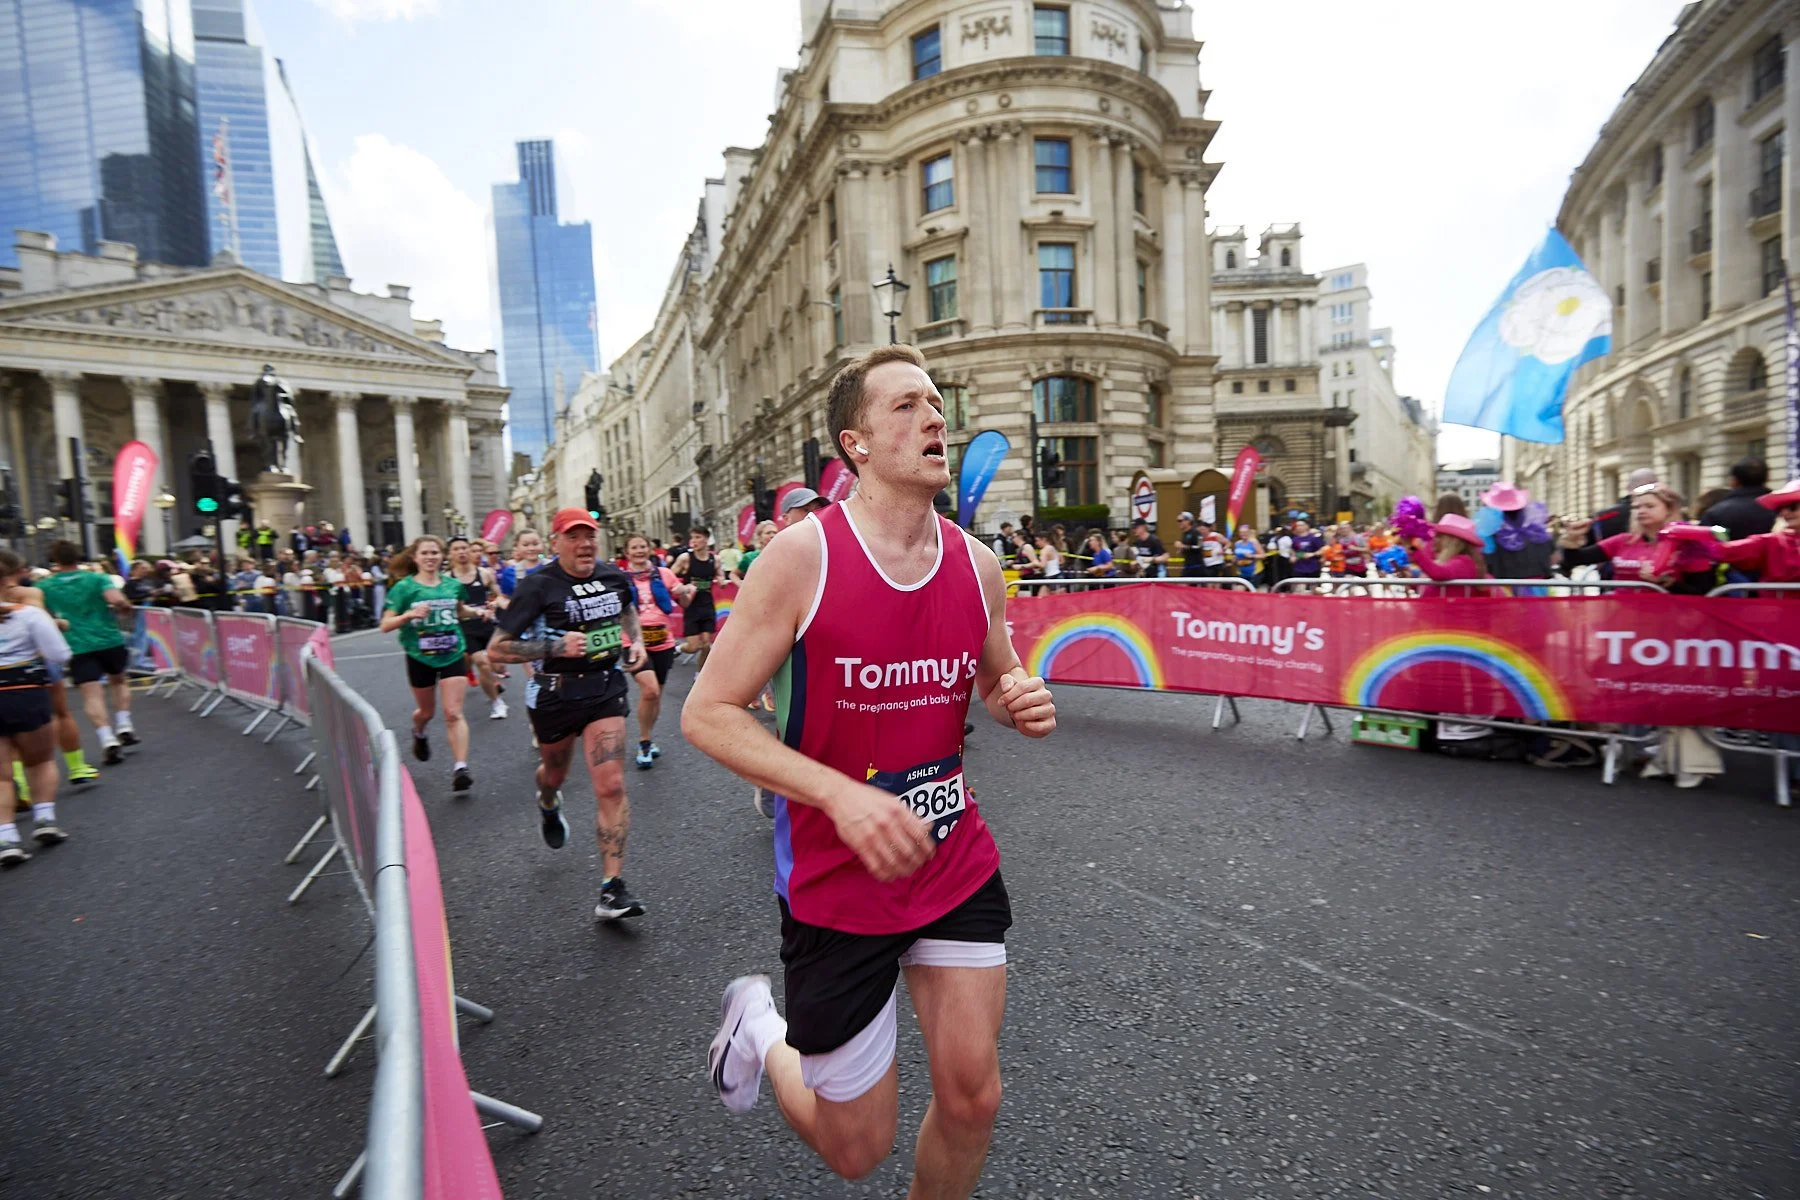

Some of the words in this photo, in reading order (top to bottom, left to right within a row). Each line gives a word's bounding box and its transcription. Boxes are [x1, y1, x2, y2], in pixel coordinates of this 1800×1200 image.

[572, 580, 606, 596] ROB
[1170, 611, 1325, 655] Tommy's
[835, 652, 977, 689] Tommy's
[1188, 650, 1235, 663] pregnancy
[1237, 655, 1254, 665] and
[1256, 656, 1282, 669] baby
[1284, 659, 1324, 673] charity
[1595, 678, 1627, 690] The
[1630, 681, 1729, 698] pregnancy
[1732, 685, 1772, 697] and
[836, 699, 856, 710] The
[860, 699, 909, 714] pregnancy
[910, 695, 927, 707] and
[930, 693, 950, 704] baby
[906, 765, 940, 782] ASHLEY
